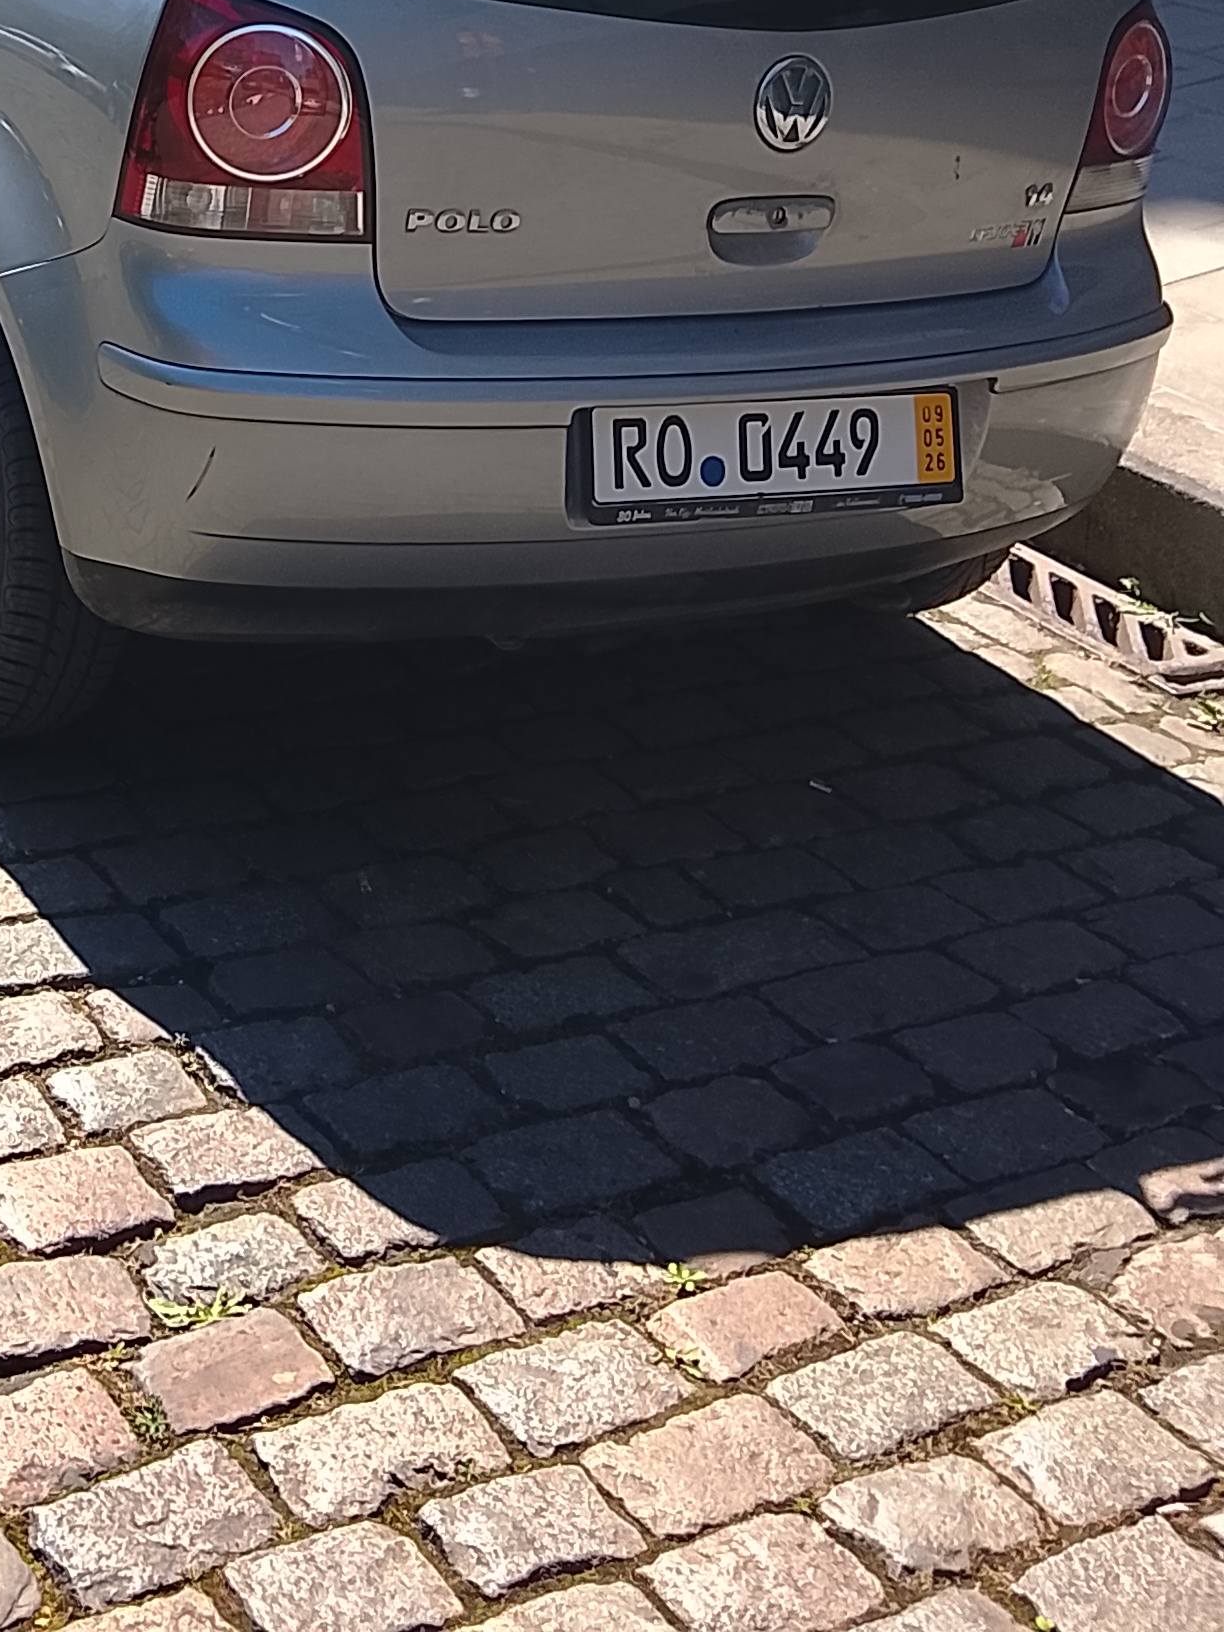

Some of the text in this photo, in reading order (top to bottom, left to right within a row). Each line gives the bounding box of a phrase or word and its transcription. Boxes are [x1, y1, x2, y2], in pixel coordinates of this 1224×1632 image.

[405, 208, 521, 234] POLO
[922, 405, 944, 423] 09
[923, 428, 945, 448] 05
[612, 415, 693, 490] RO
[924, 452, 946, 472] 26
